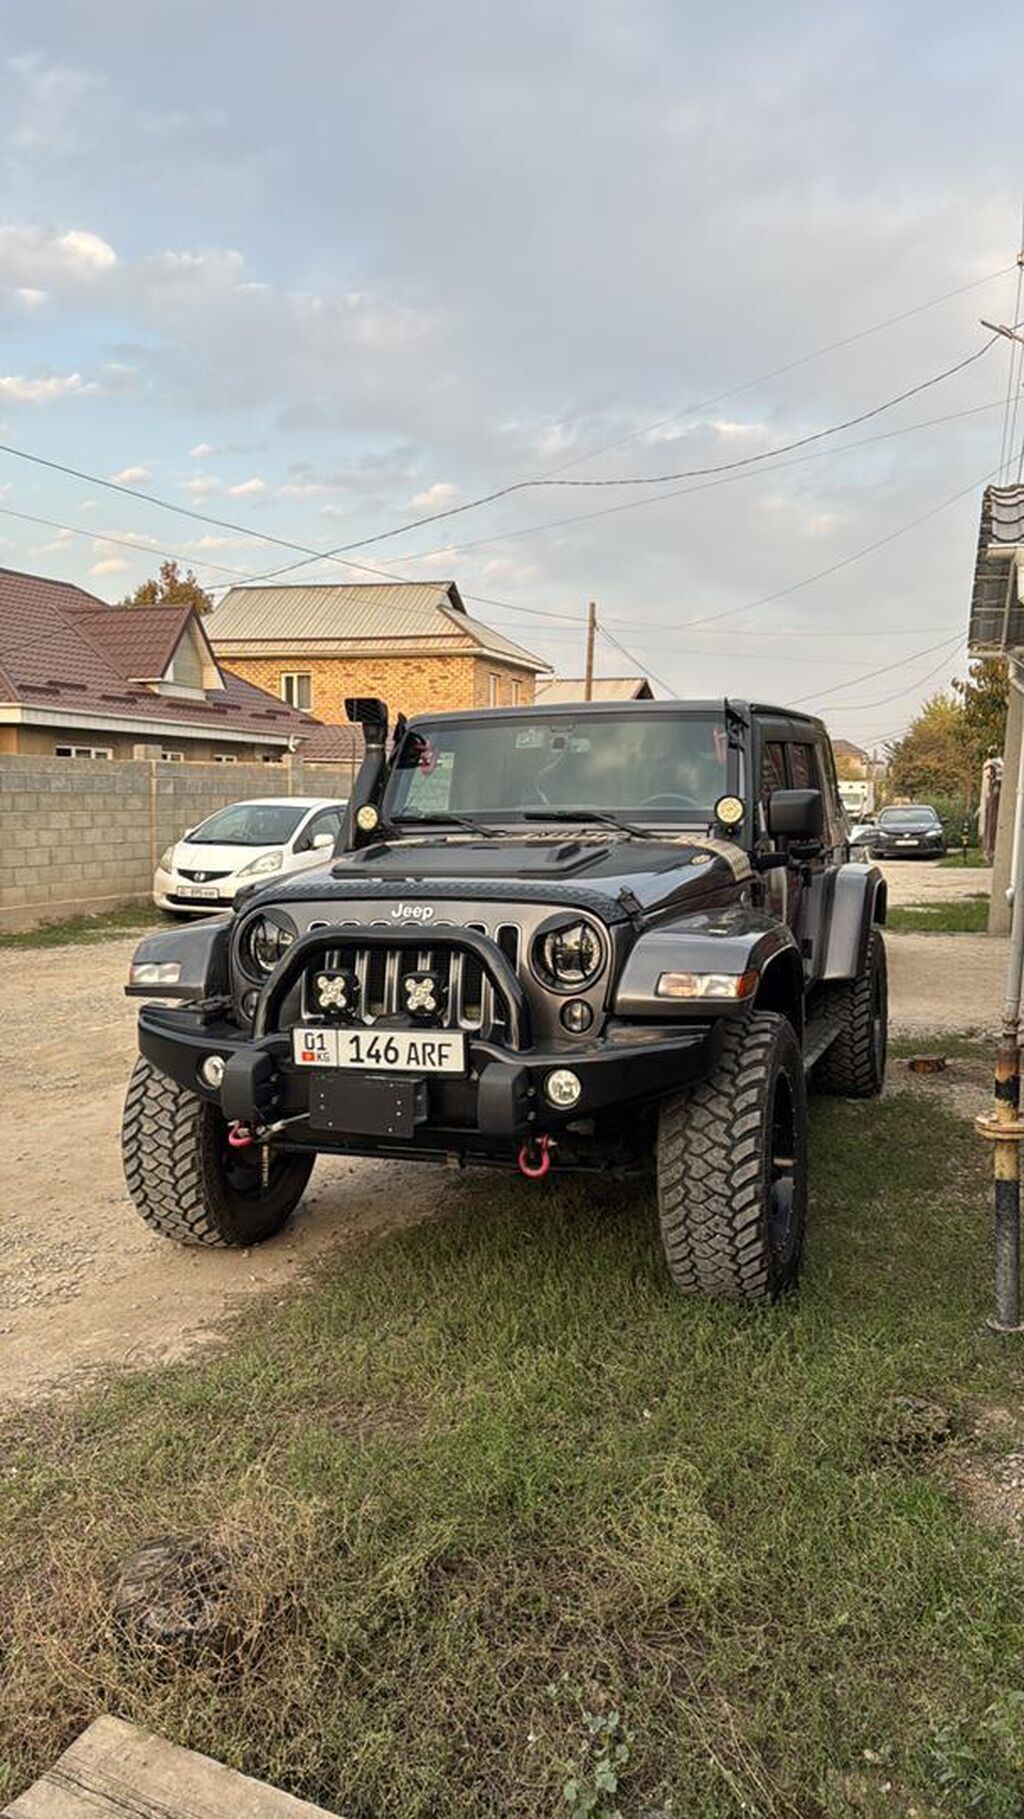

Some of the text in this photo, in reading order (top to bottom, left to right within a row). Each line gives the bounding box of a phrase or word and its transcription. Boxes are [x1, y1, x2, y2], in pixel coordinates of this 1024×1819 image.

[391, 903, 433, 920] Jeep
[304, 1032, 326, 1050] 01
[316, 1053, 330, 1062] KG
[349, 1035, 453, 1067] 146 ARF
